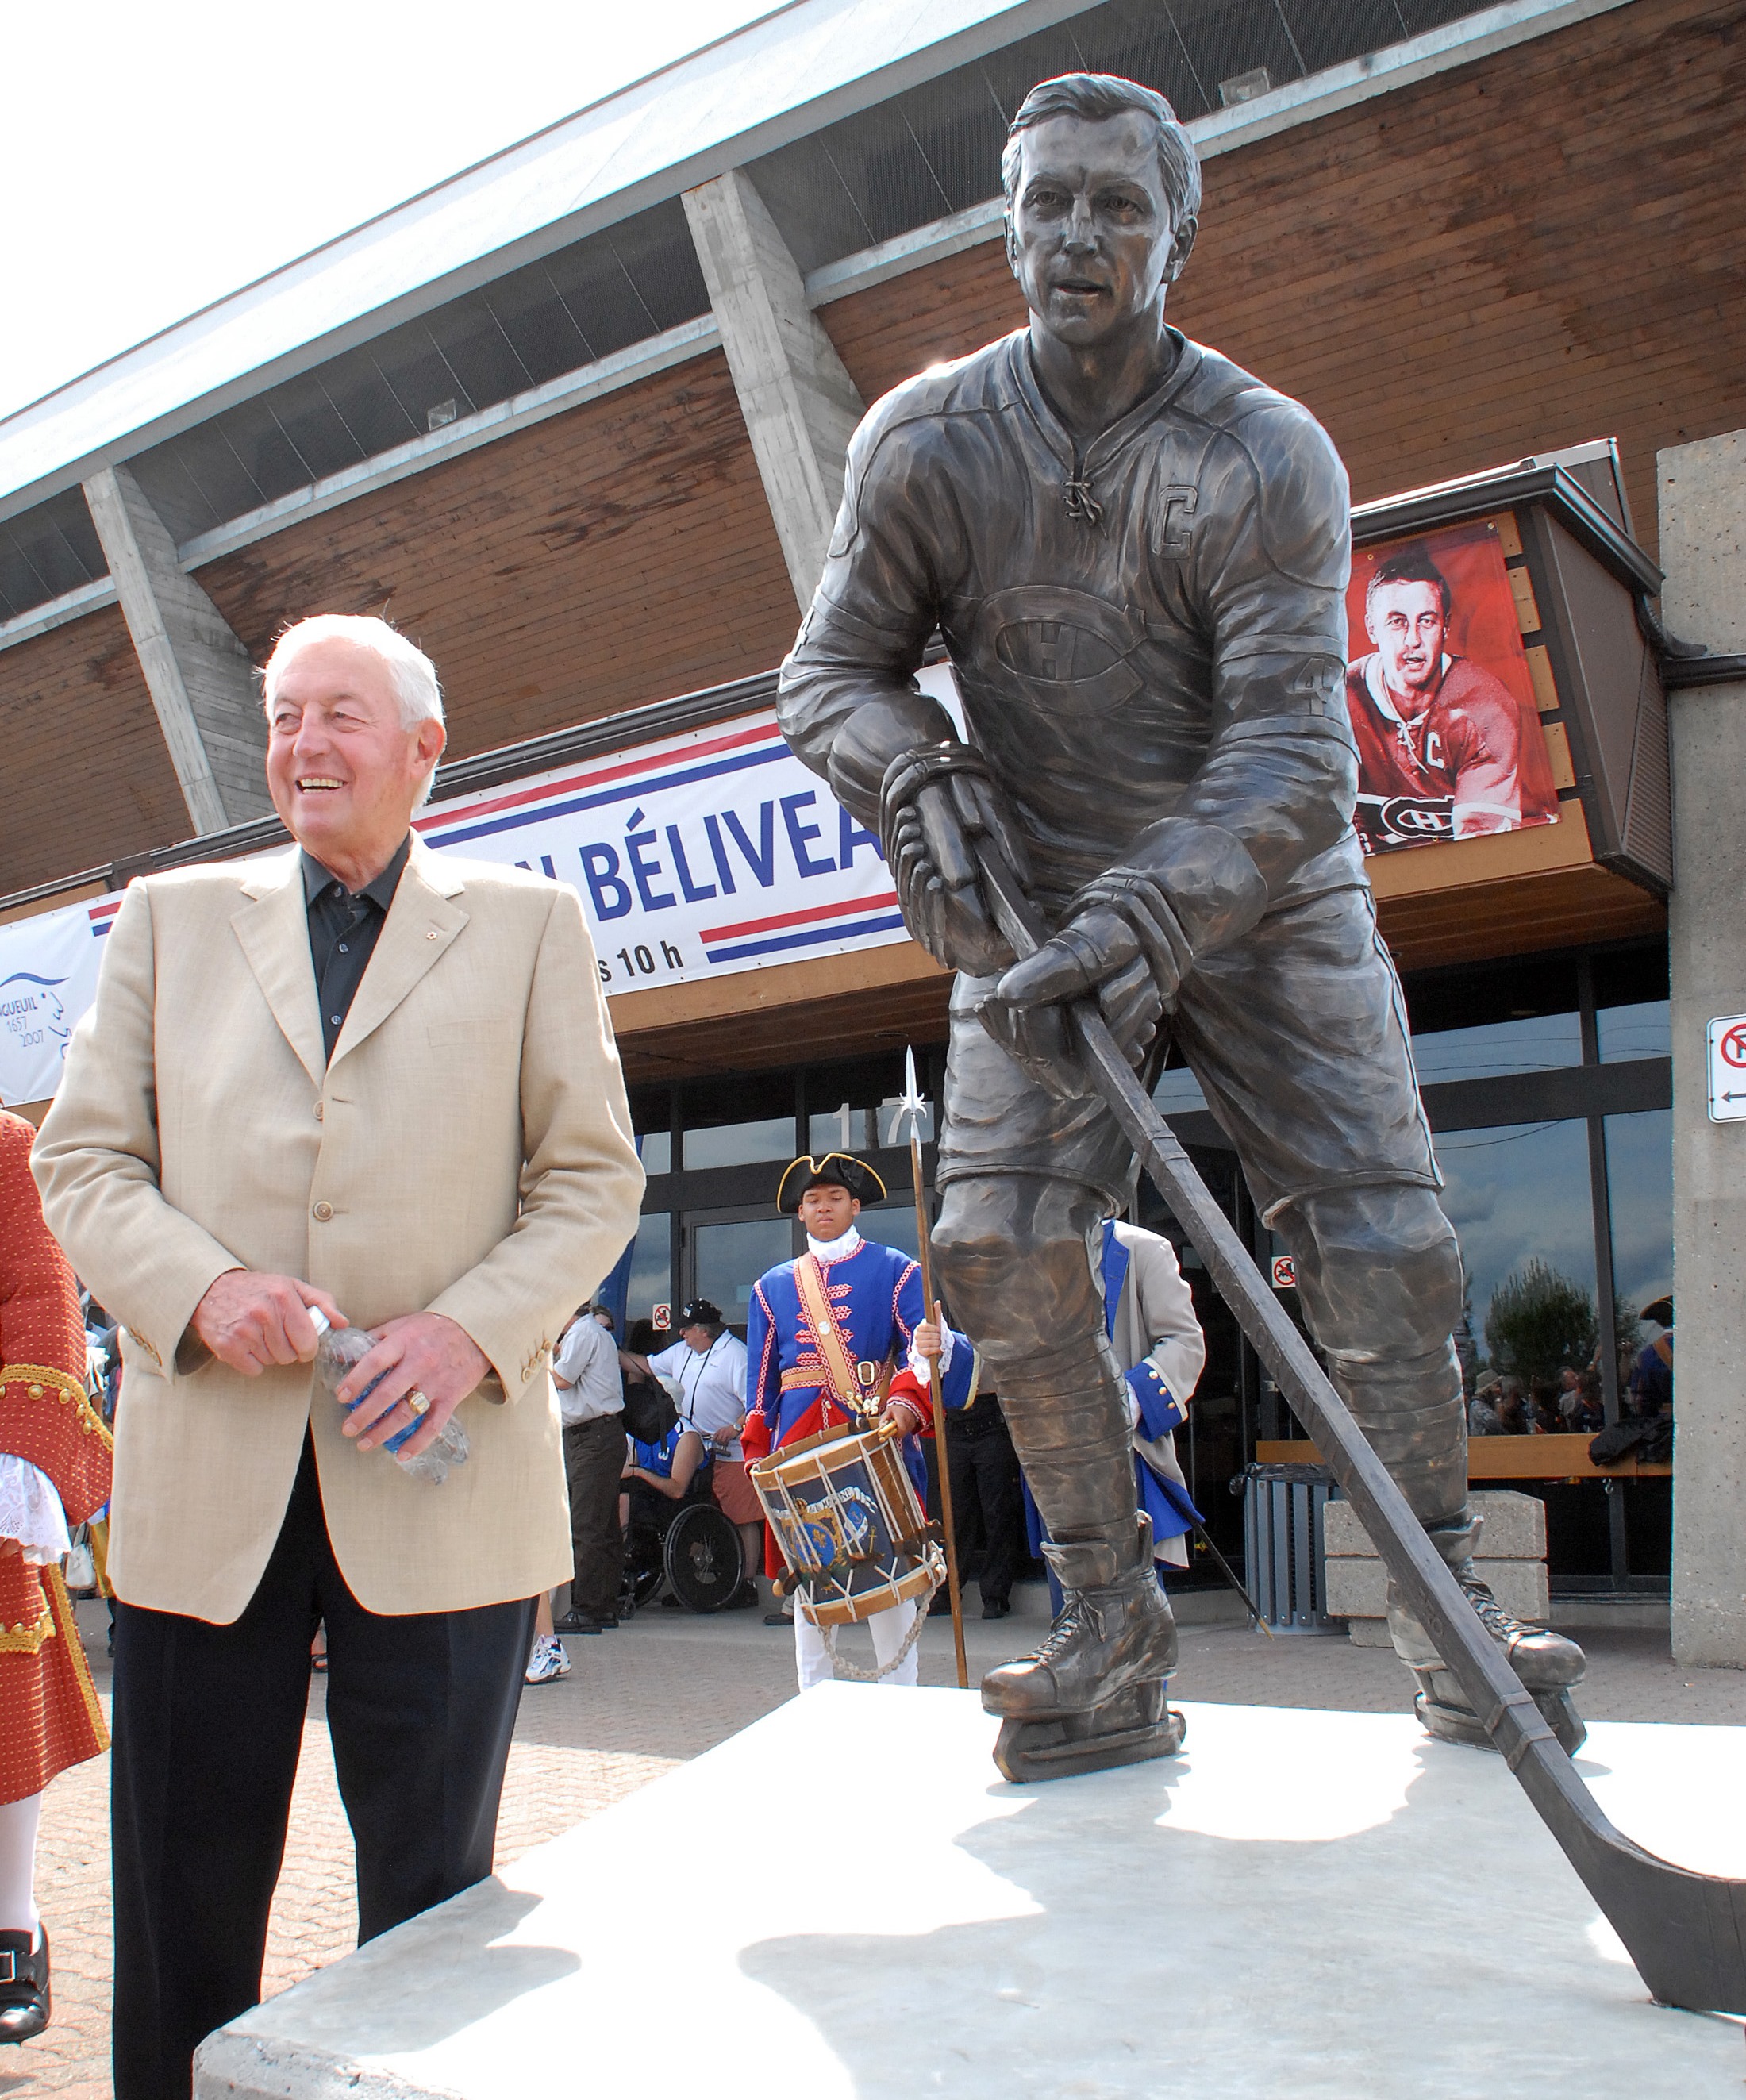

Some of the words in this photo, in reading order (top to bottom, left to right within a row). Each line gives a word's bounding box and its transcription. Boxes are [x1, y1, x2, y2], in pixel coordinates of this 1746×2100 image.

[1152, 485, 1198, 560] C
[1427, 731, 1445, 769] C
[617, 944, 656, 977] 10
[660, 940, 683, 969] h
[0, 997, 38, 1017] GUEUIL
[7, 1016, 26, 1033] 1657
[19, 1029, 44, 1047] 2007
